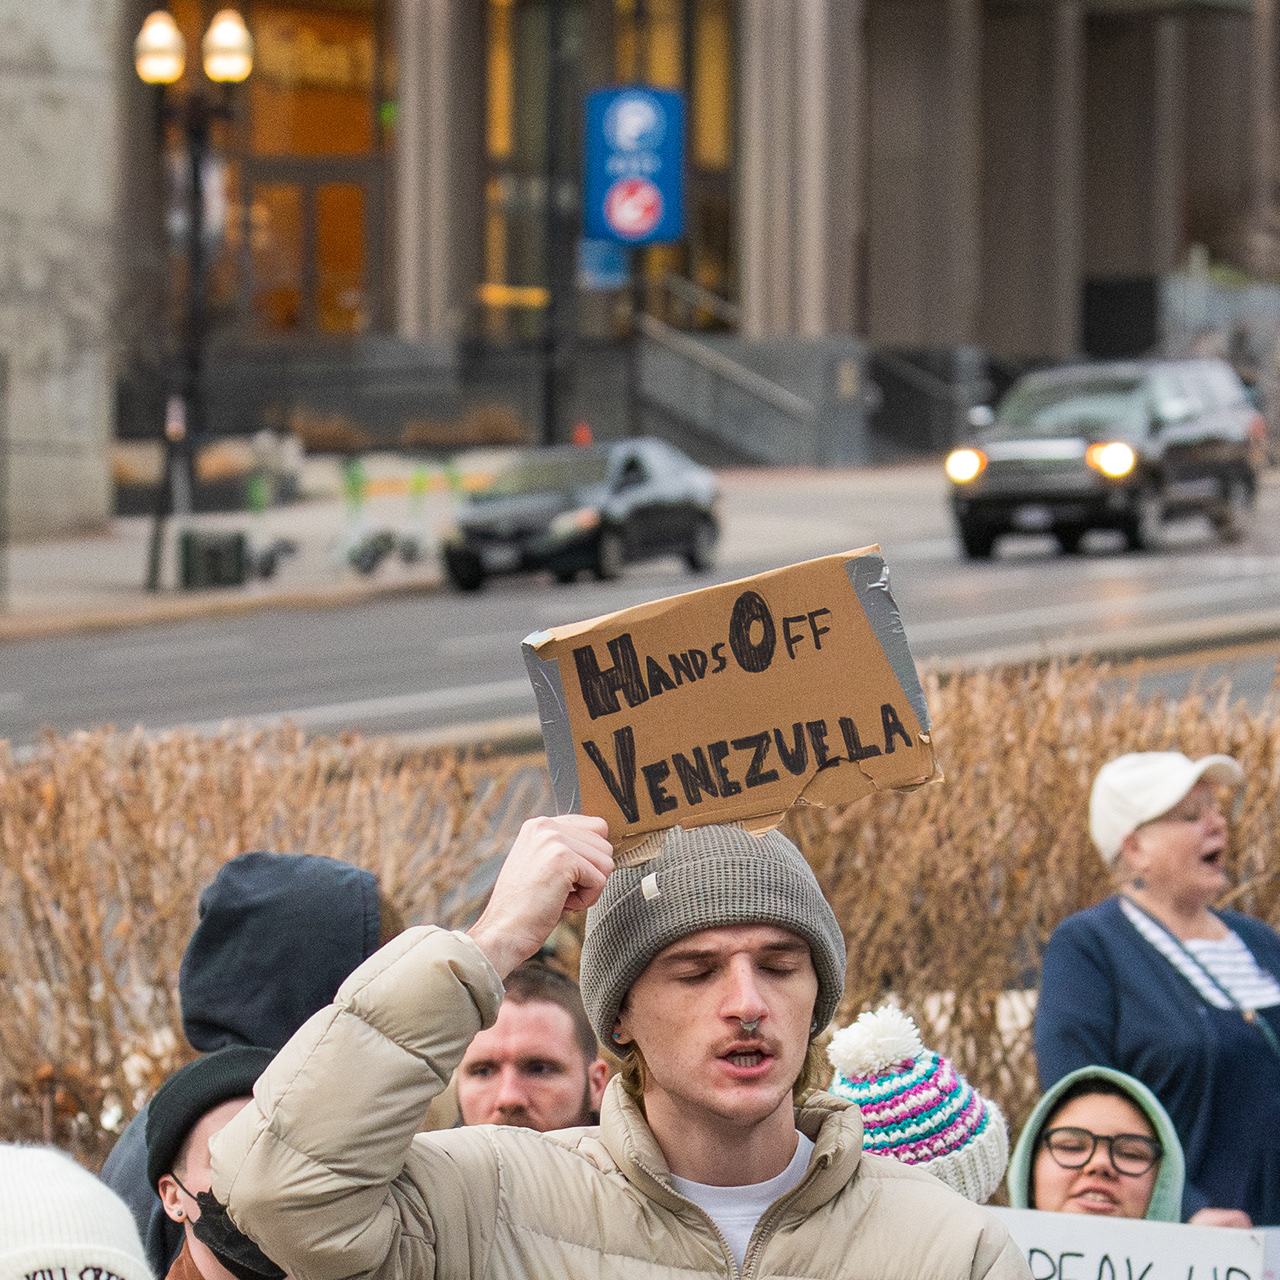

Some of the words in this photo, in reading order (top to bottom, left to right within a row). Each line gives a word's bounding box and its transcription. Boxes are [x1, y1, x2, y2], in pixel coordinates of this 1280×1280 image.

[573, 632, 726, 719] HANDS
[729, 590, 831, 673] OFF
[582, 703, 913, 825] VENEZUELA
